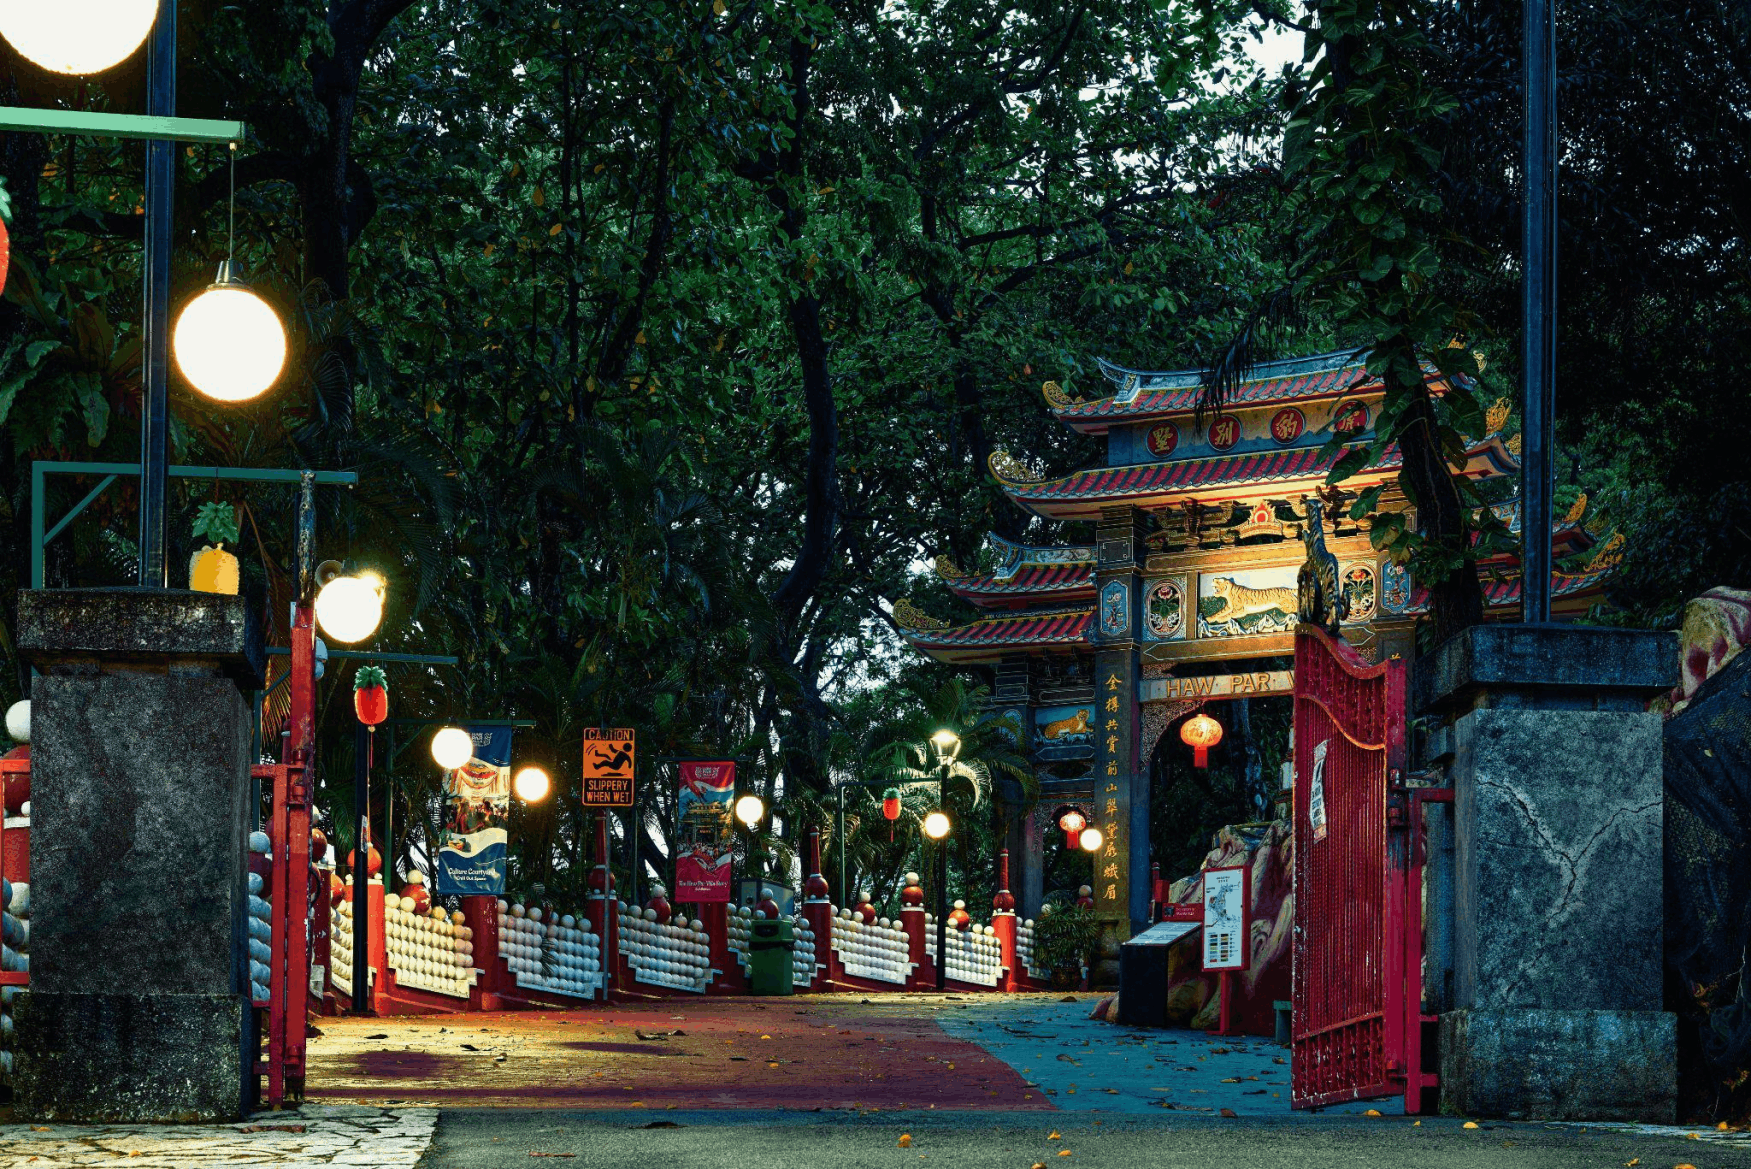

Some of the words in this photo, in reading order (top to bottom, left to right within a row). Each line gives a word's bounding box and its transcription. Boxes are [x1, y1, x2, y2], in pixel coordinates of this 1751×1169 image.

[1166, 676, 1215, 698] HAW
[1230, 672, 1271, 693] PAR
[588, 729, 630, 741] CAUTION
[588, 780, 628, 791] SLIPPERY
[586, 791, 611, 802] WHEN
[613, 791, 630, 803] WET
[448, 867, 467, 875] Culture
